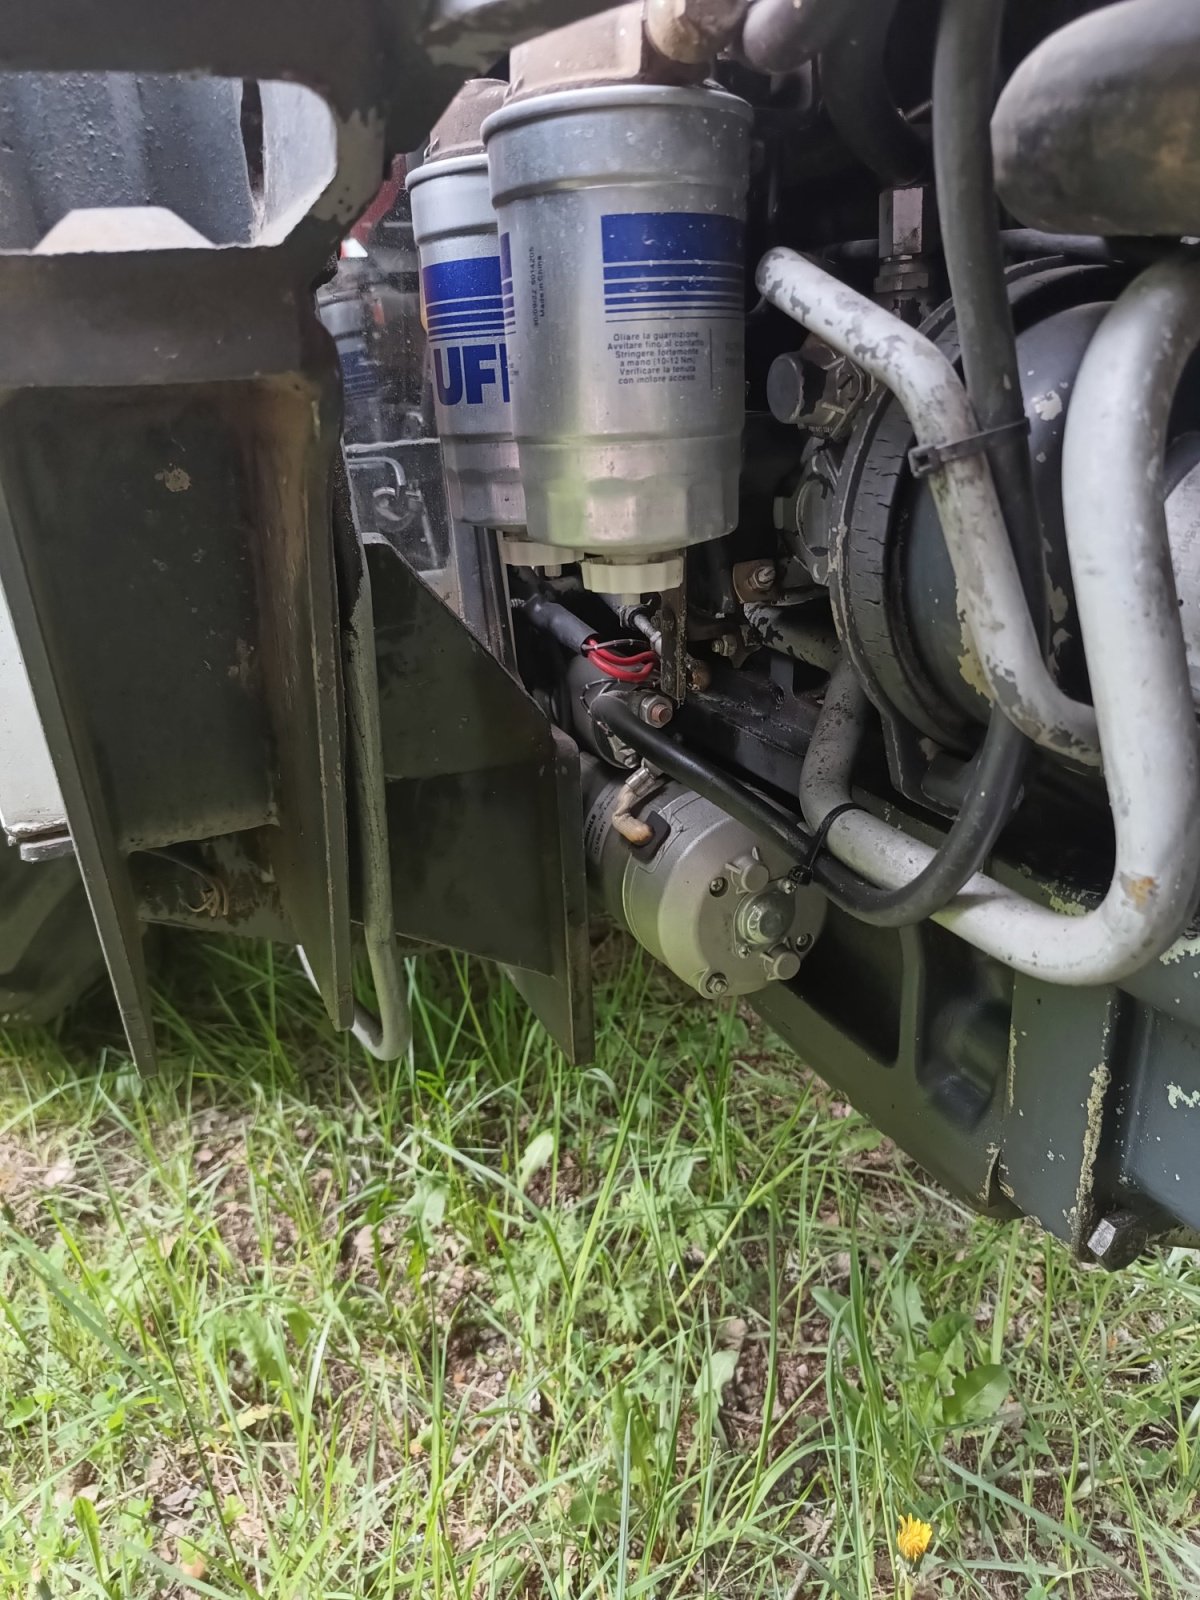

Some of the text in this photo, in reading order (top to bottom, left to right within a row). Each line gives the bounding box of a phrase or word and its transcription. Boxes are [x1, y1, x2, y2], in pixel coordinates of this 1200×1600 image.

[613, 333, 640, 341] Oliare
[653, 331, 699, 341] guarnizione
[607, 342, 642, 350] Avvitare
[675, 339, 705, 347] contatto
[615, 348, 699, 359] Stringere fortemente
[619, 367, 660, 376] Verificare
[672, 365, 696, 373] tenuta
[636, 376, 666, 384] motore
